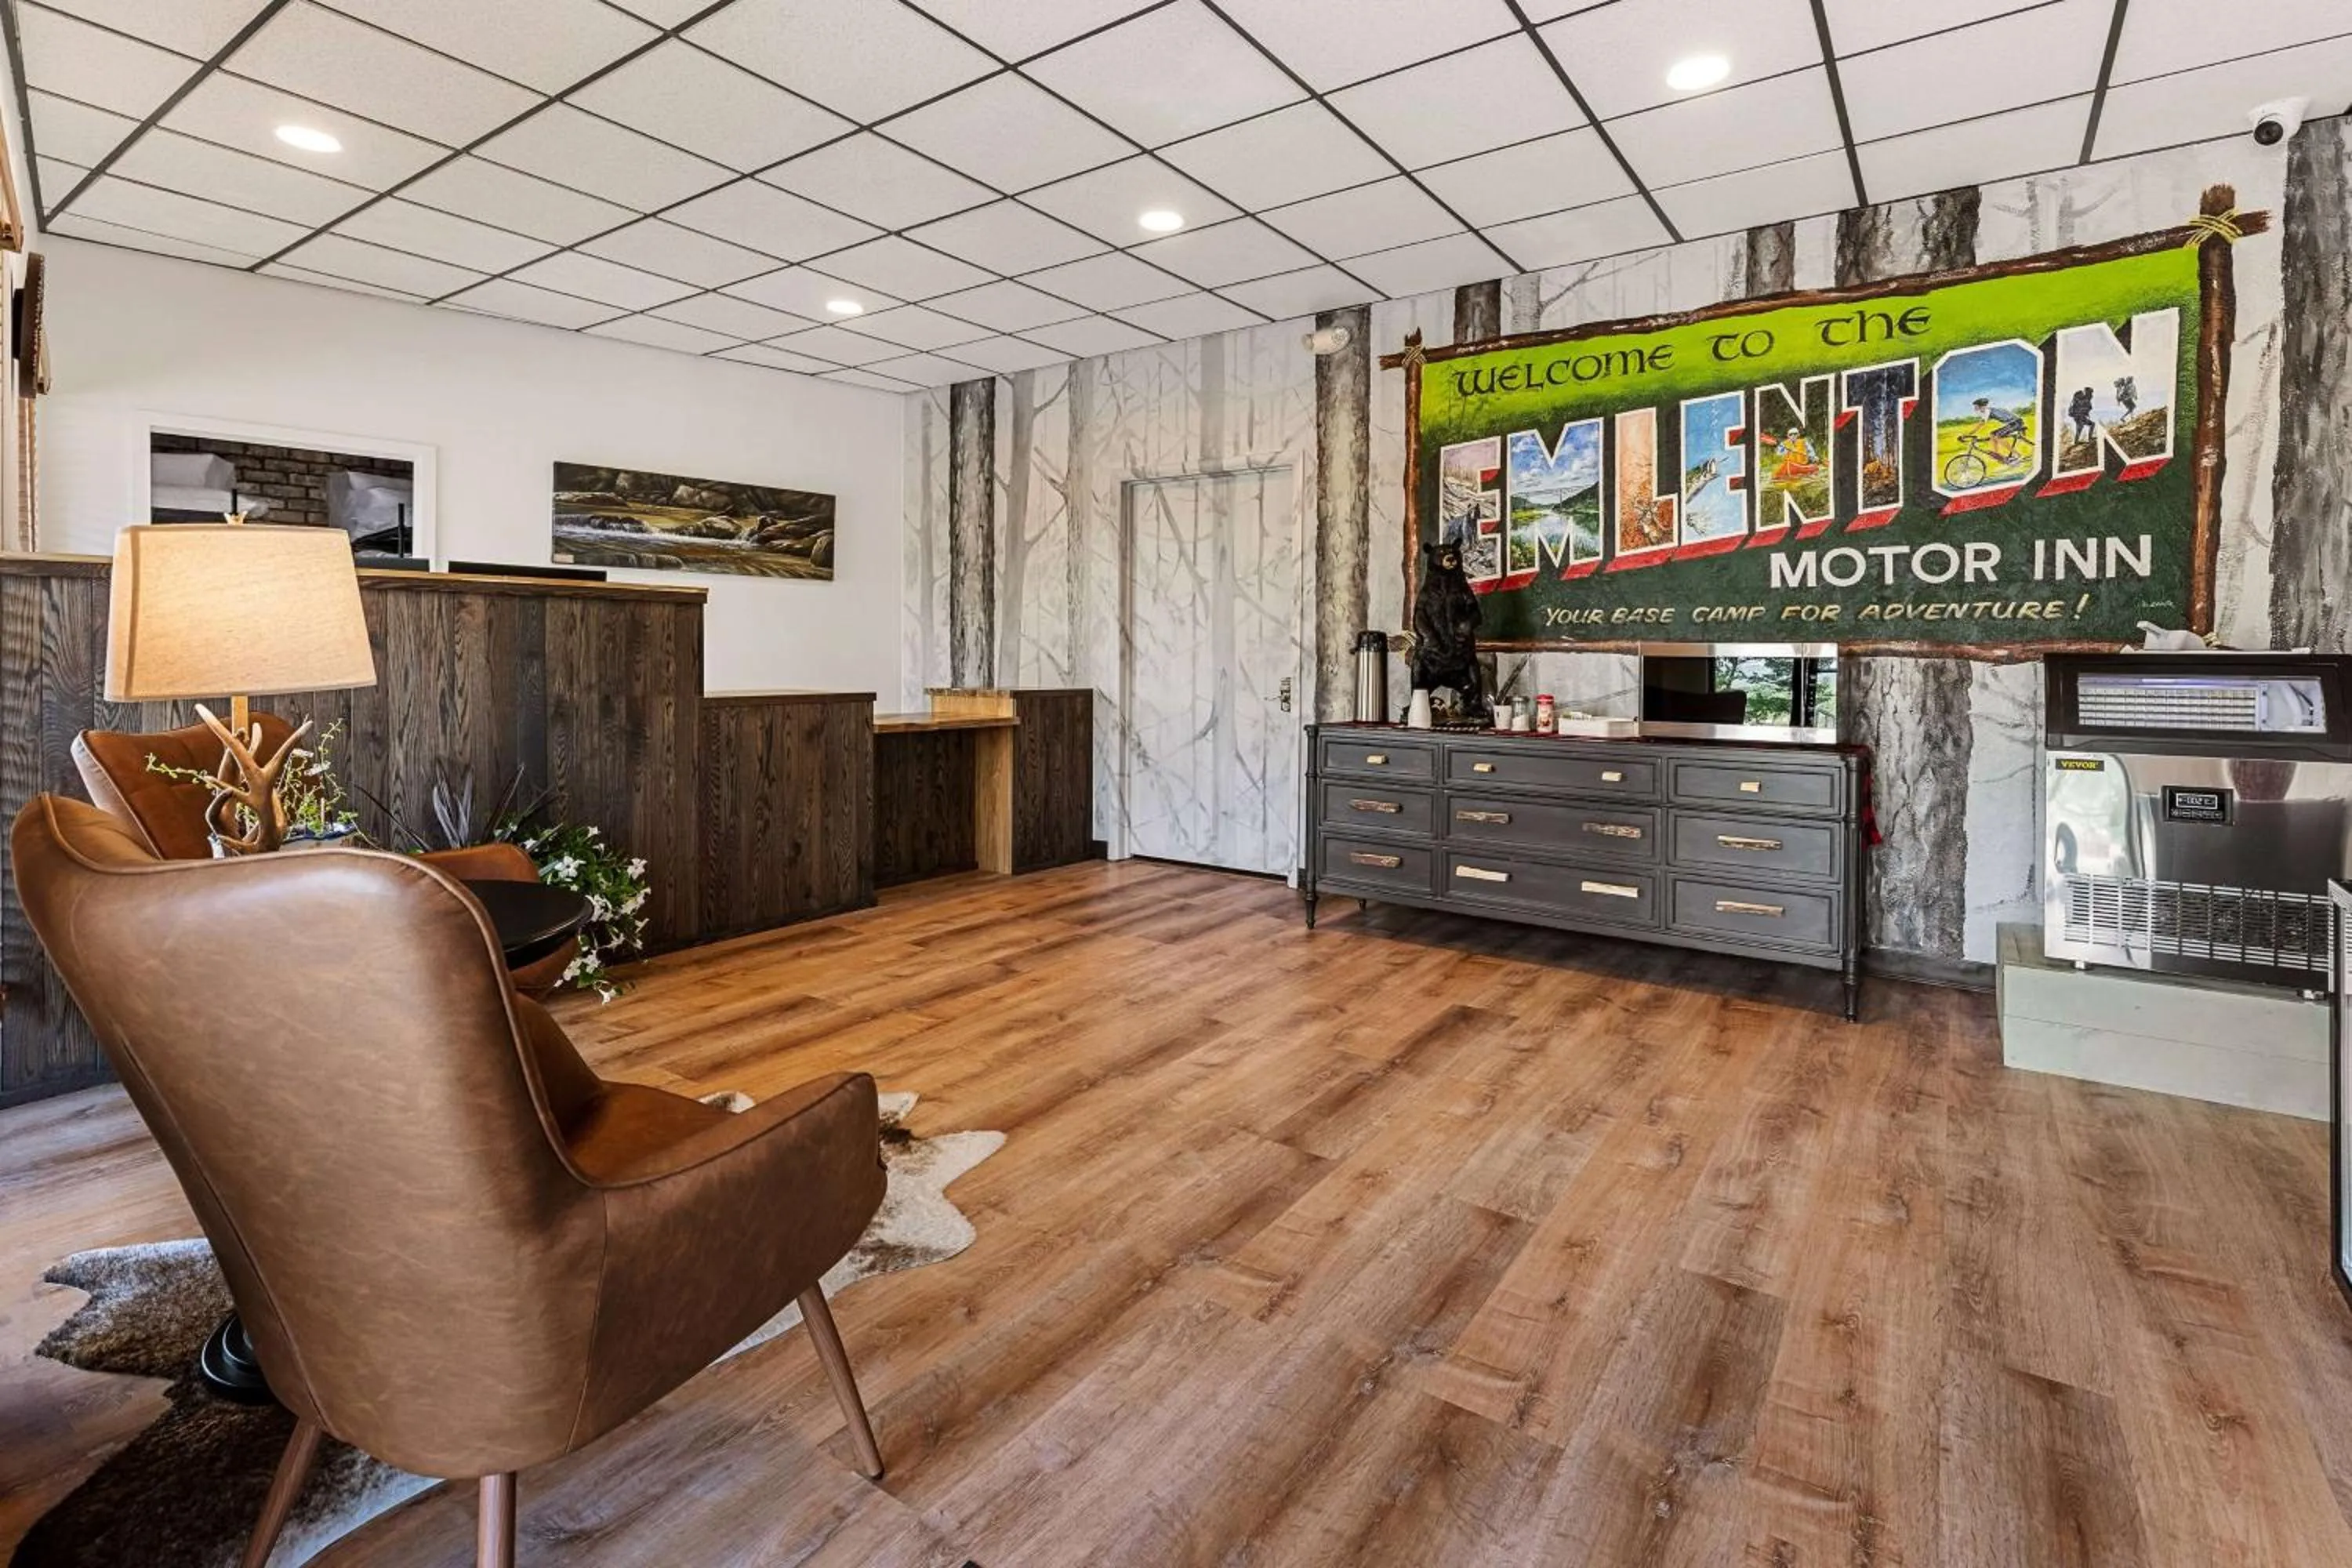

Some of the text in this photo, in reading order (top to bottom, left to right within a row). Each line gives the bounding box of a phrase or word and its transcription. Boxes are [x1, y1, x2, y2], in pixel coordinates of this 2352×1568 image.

[1453, 343, 1676, 397] WELCOME
[1706, 328, 1775, 362] TO
[1439, 307, 2180, 583] EMLENTON
[1769, 534, 2153, 589] MOTOR INN
[1544, 607, 1604, 626] YOUR
[1610, 606, 1676, 624] BASE
[1692, 605, 1766, 622] CAMP
[1780, 604, 1842, 622] FOR
[2061, 760, 2096, 769] VEVOR
